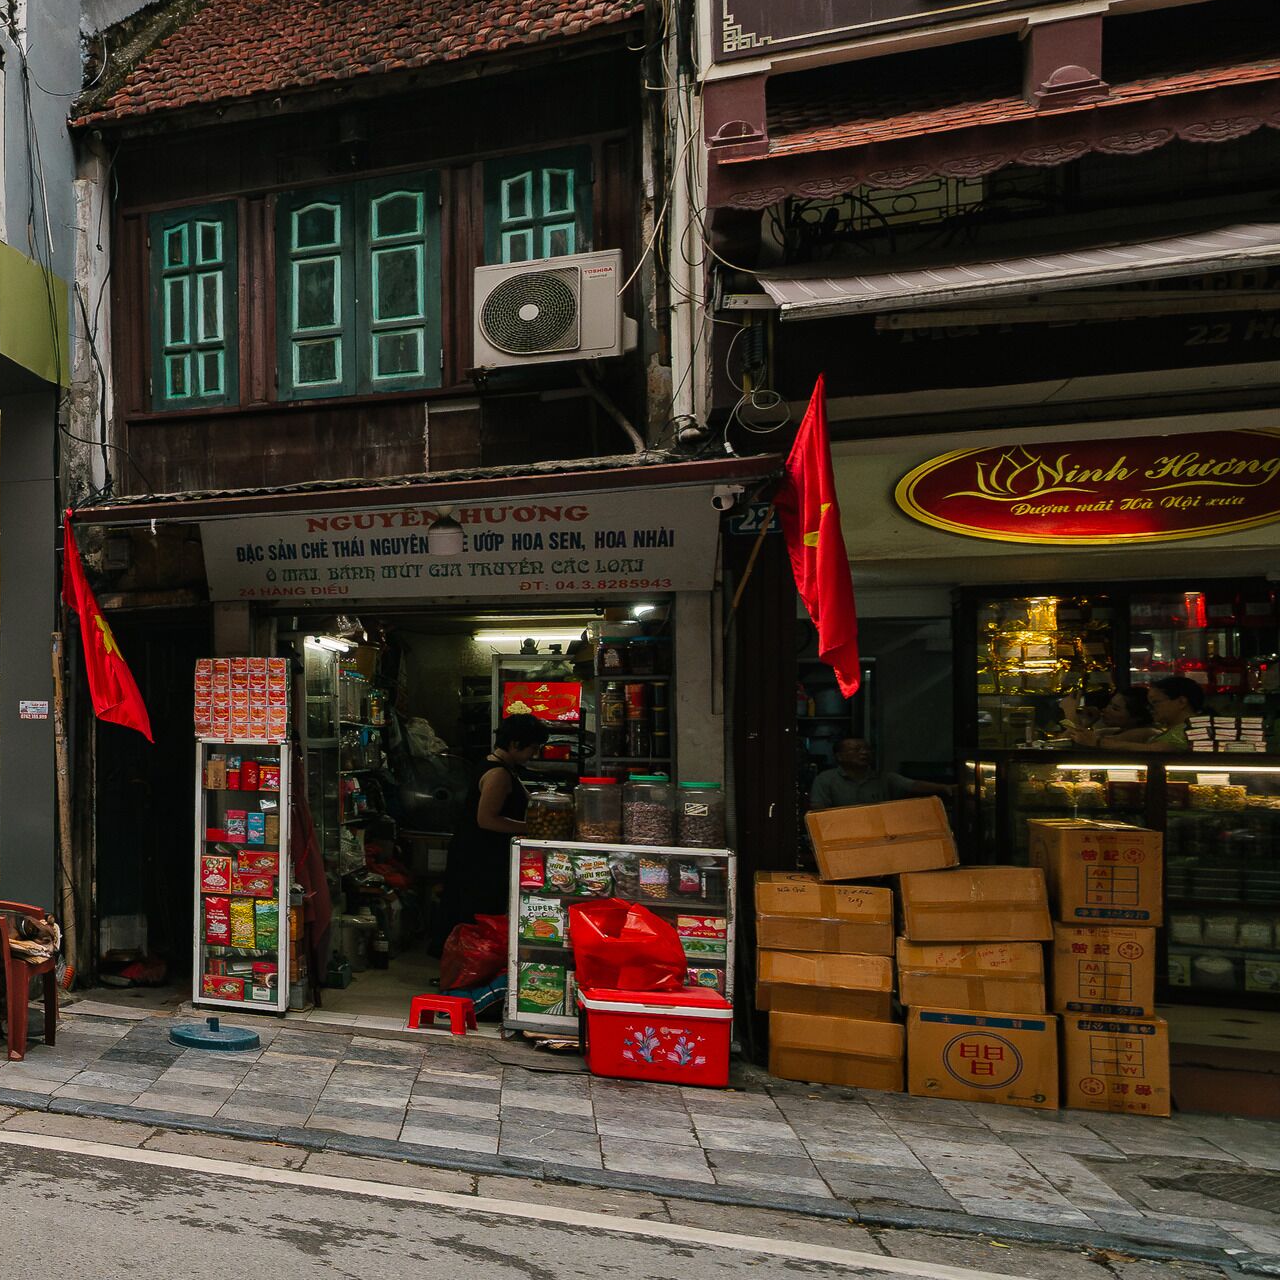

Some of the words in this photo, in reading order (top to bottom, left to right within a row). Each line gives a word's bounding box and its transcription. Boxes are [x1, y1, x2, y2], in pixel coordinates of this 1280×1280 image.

[584, 267, 613, 275] TOSHIBA
[1028, 453, 1139, 495] Ninh
[1144, 452, 1280, 488] Hương
[1075, 498, 1114, 513] mãi
[1121, 495, 1154, 511] Hà
[1160, 495, 1201, 512] Nội
[1205, 495, 1246, 507] xưa
[459, 505, 590, 524] HƯƠNG
[738, 506, 776, 530] 22
[236, 543, 265, 564] ĐẶC
[269, 539, 297, 561] SẢN
[332, 536, 365, 558] THÁI
[370, 533, 430, 556] NGUYÊN
[474, 529, 505, 552] ƯỚP
[512, 532, 544, 551] HOA
[549, 531, 586, 552] SEN,
[594, 529, 627, 549] HOA
[429, 563, 463, 578] GIA
[552, 557, 590, 574] CÁC
[595, 557, 645, 576] LOẠI
[240, 588, 256, 597] 24
[520, 581, 549, 591] ĐT:
